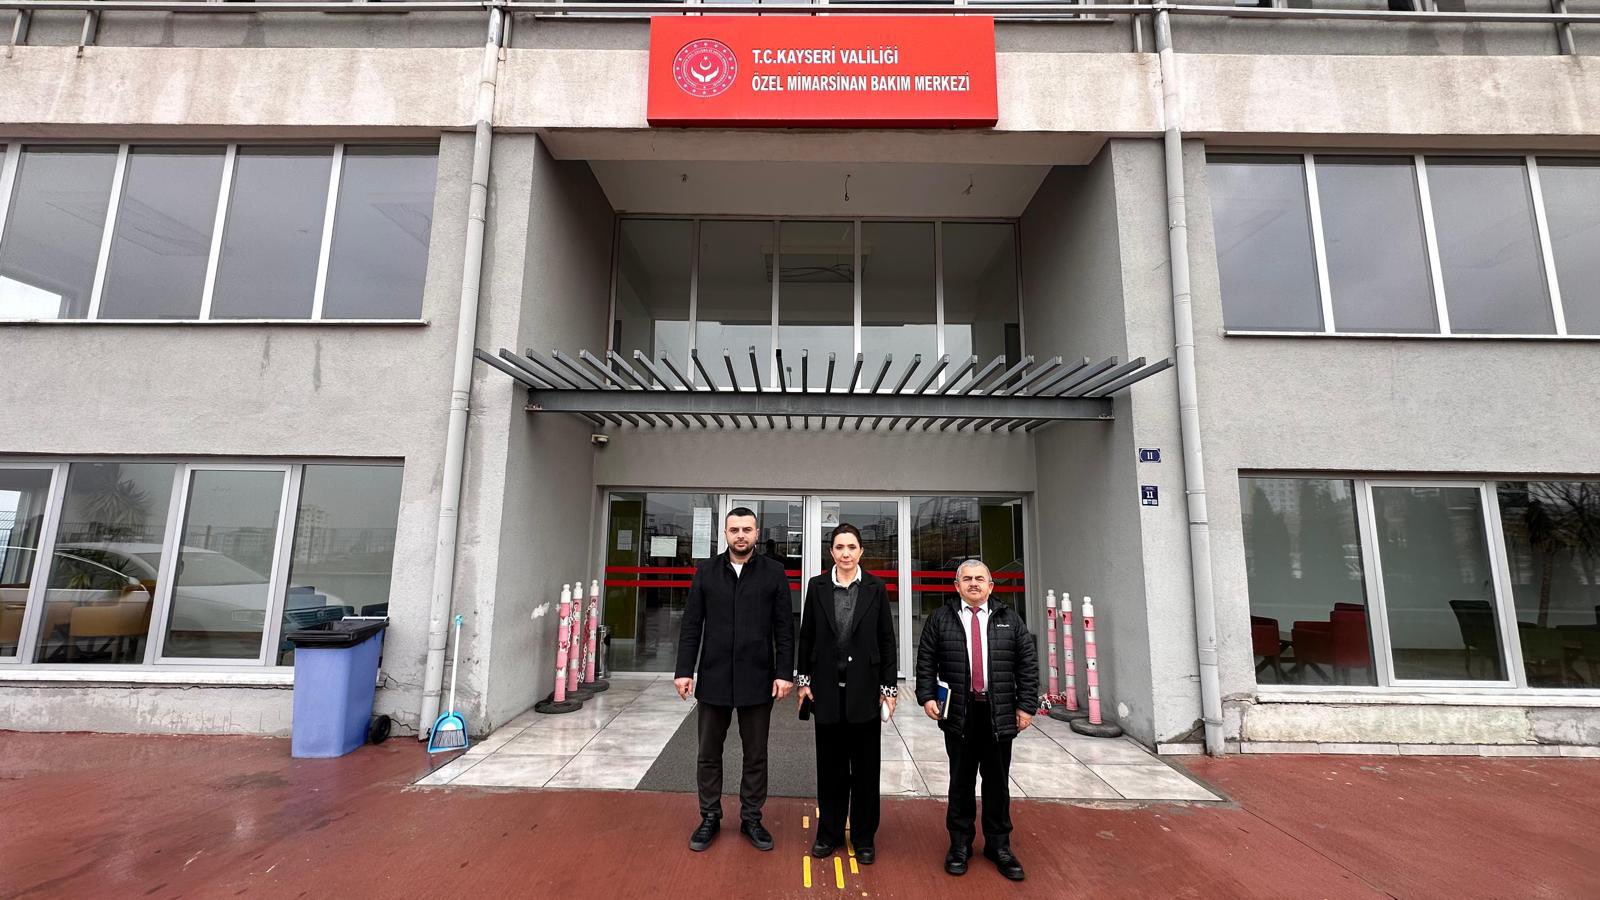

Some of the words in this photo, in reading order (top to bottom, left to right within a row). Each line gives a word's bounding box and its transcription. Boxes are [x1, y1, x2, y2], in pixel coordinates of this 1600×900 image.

[752, 46, 836, 64] T.C.KAYSERİ
[840, 46, 899, 64] VALİLİĞİ
[752, 72, 784, 91] ÖZEL
[787, 71, 867, 91] MİMARSİNAN
[871, 75, 911, 91] BAKIM
[915, 72, 970, 91] MERKEZİ
[1147, 452, 1153, 460] 11
